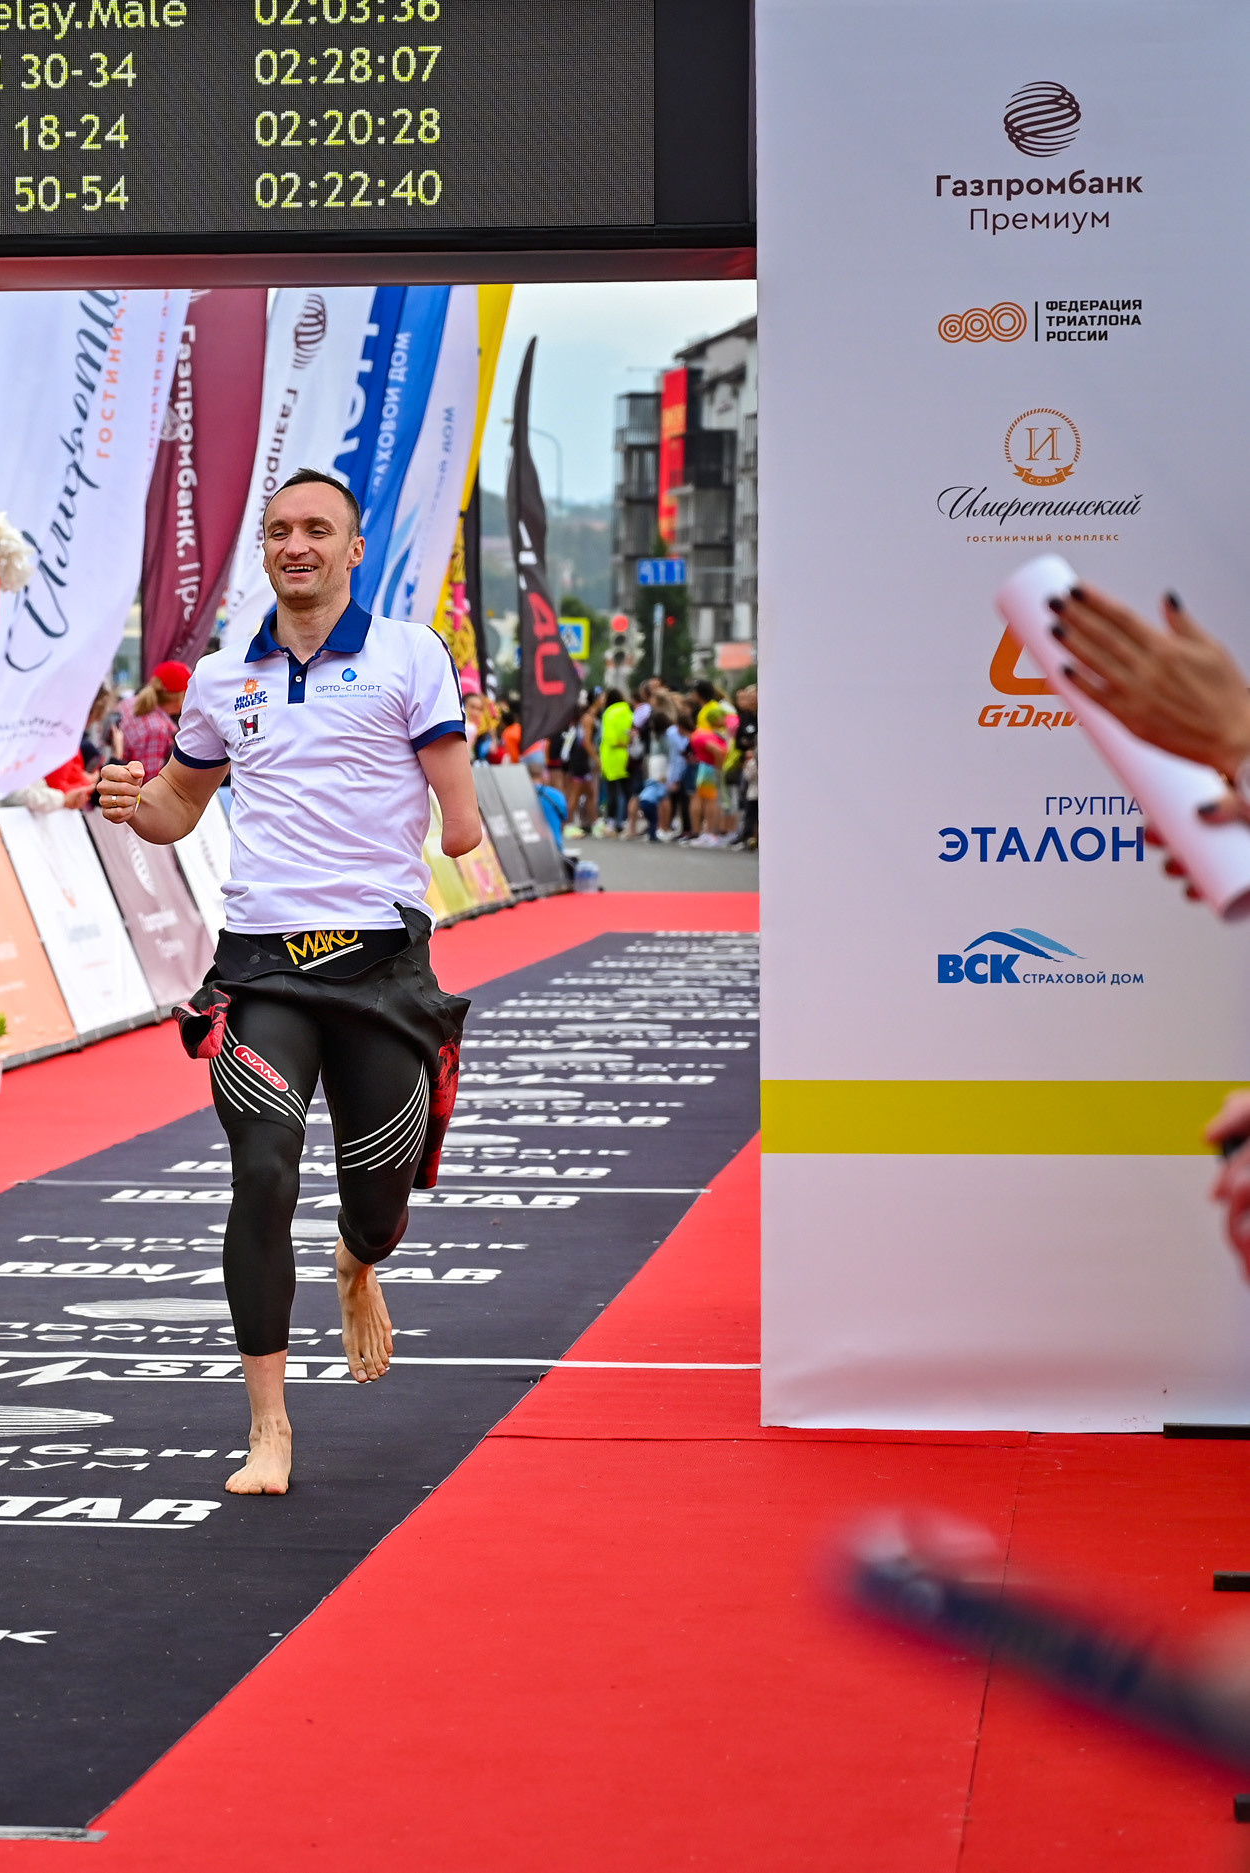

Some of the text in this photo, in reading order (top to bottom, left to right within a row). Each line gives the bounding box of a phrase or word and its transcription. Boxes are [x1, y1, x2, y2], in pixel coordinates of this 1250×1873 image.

[21, 52, 137, 89] 30-34
[255, 46, 442, 85] 02:28:07
[14, 113, 129, 151] 18-24
[255, 107, 441, 146] 02:20:28
[14, 174, 129, 212] 50-54
[255, 170, 442, 208] 02:22:40
[935, 169, 1143, 201] Газпромбанк
[969, 208, 1110, 235] Премиум
[1045, 298, 1143, 313] ФЕДЕРАЦИЯ
[1045, 315, 1142, 328] ТРИАТЛОНА
[1046, 331, 1109, 342] РОССИИ
[1028, 476, 1059, 484] СОЧИ
[937, 486, 1143, 525] Имеретинский
[966, 532, 1120, 543] ГОСТИНИЧНЫЙ КОМПЛЕКС
[315, 684, 382, 693] ОРТО-СПОРТ
[1045, 795, 1143, 815] ГРУППА
[938, 826, 1144, 863] ЭТАЛОН
[937, 954, 1145, 986] ВСК СТРАХОВОЙ ДОМ
[111, 1189, 234, 1200] IRO
